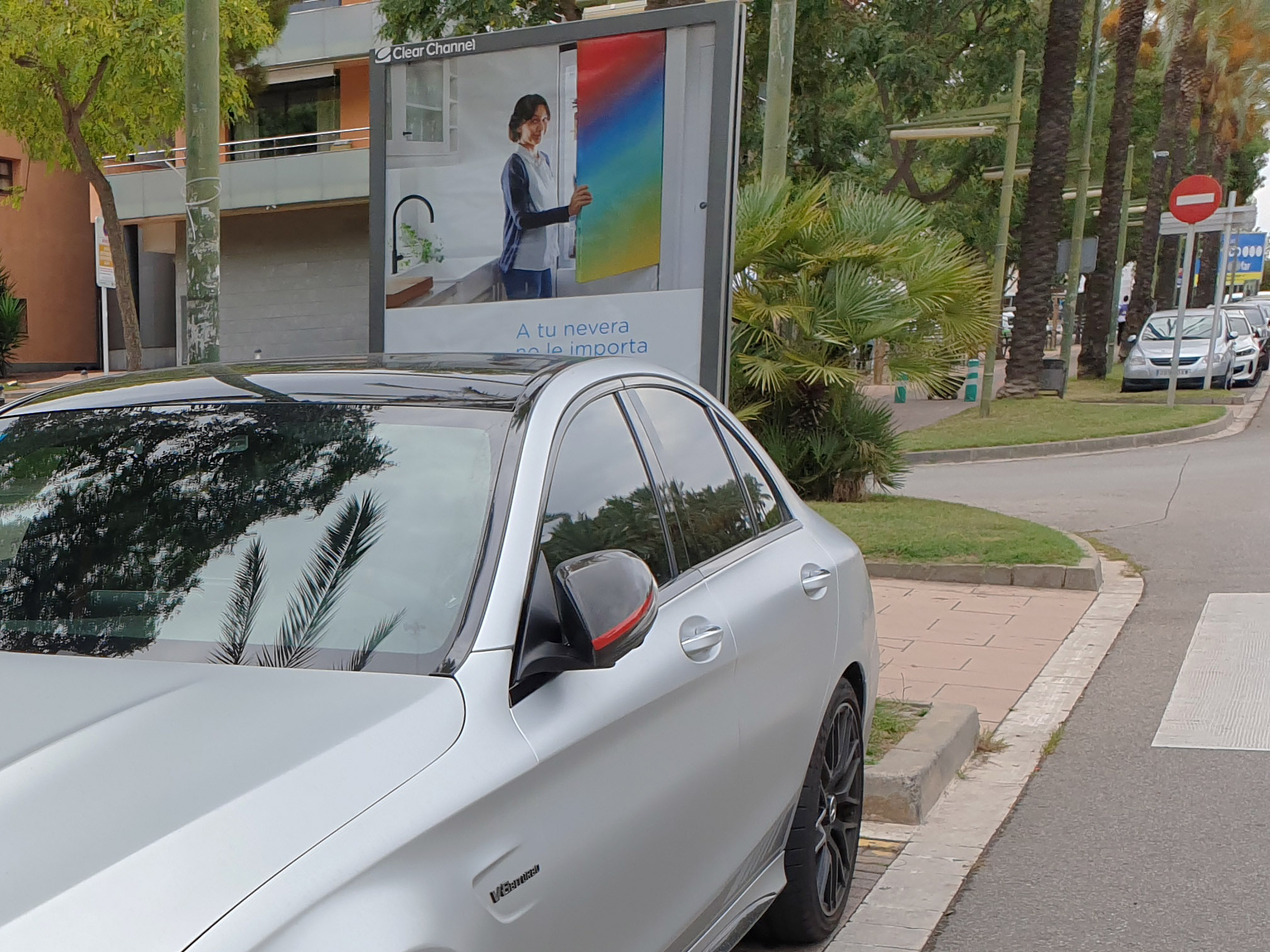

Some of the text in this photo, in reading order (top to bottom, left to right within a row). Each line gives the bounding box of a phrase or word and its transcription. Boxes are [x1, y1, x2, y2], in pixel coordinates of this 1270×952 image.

[392, 38, 476, 60] Clear Channel
[516, 321, 630, 339] A tu nevera
[570, 339, 648, 356] importa
